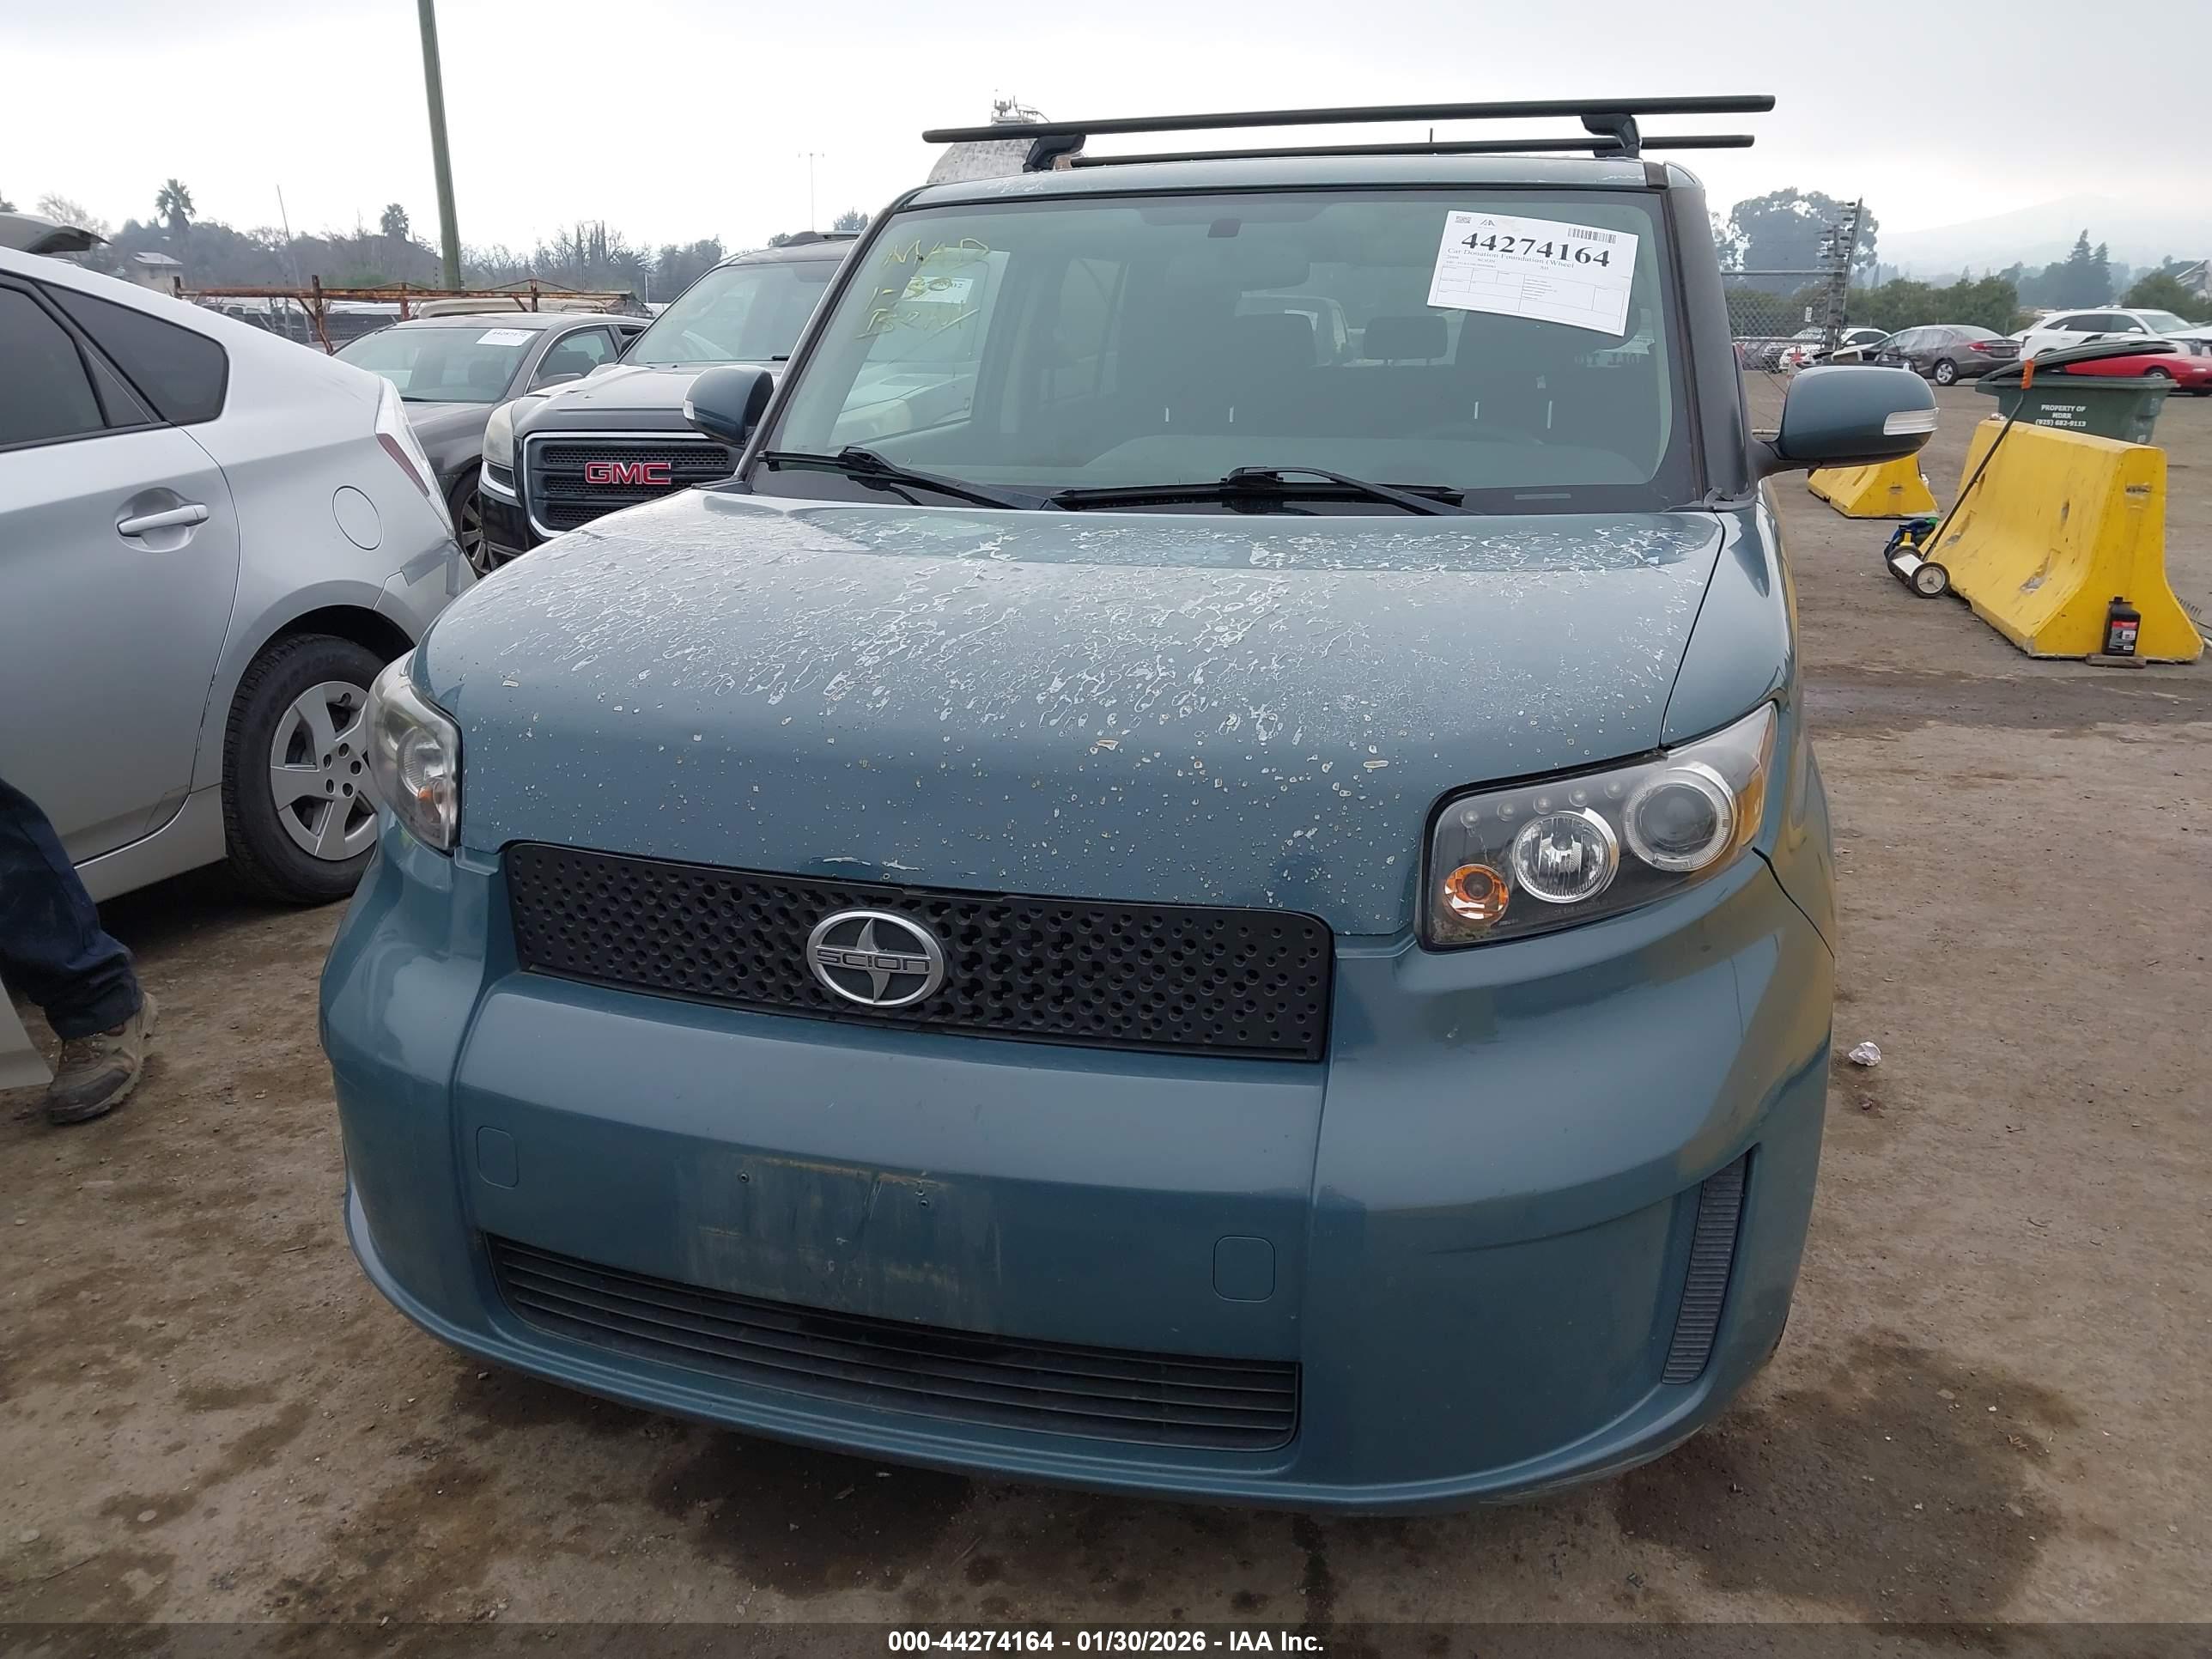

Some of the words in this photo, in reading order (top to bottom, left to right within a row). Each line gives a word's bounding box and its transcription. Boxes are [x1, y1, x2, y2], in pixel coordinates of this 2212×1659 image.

[1461, 232, 1610, 267] 44274164
[1463, 249, 1498, 258] Donation
[1501, 253, 1544, 264] Foundation
[1546, 259, 1574, 268] (Wheel
[585, 461, 672, 485] GMC
